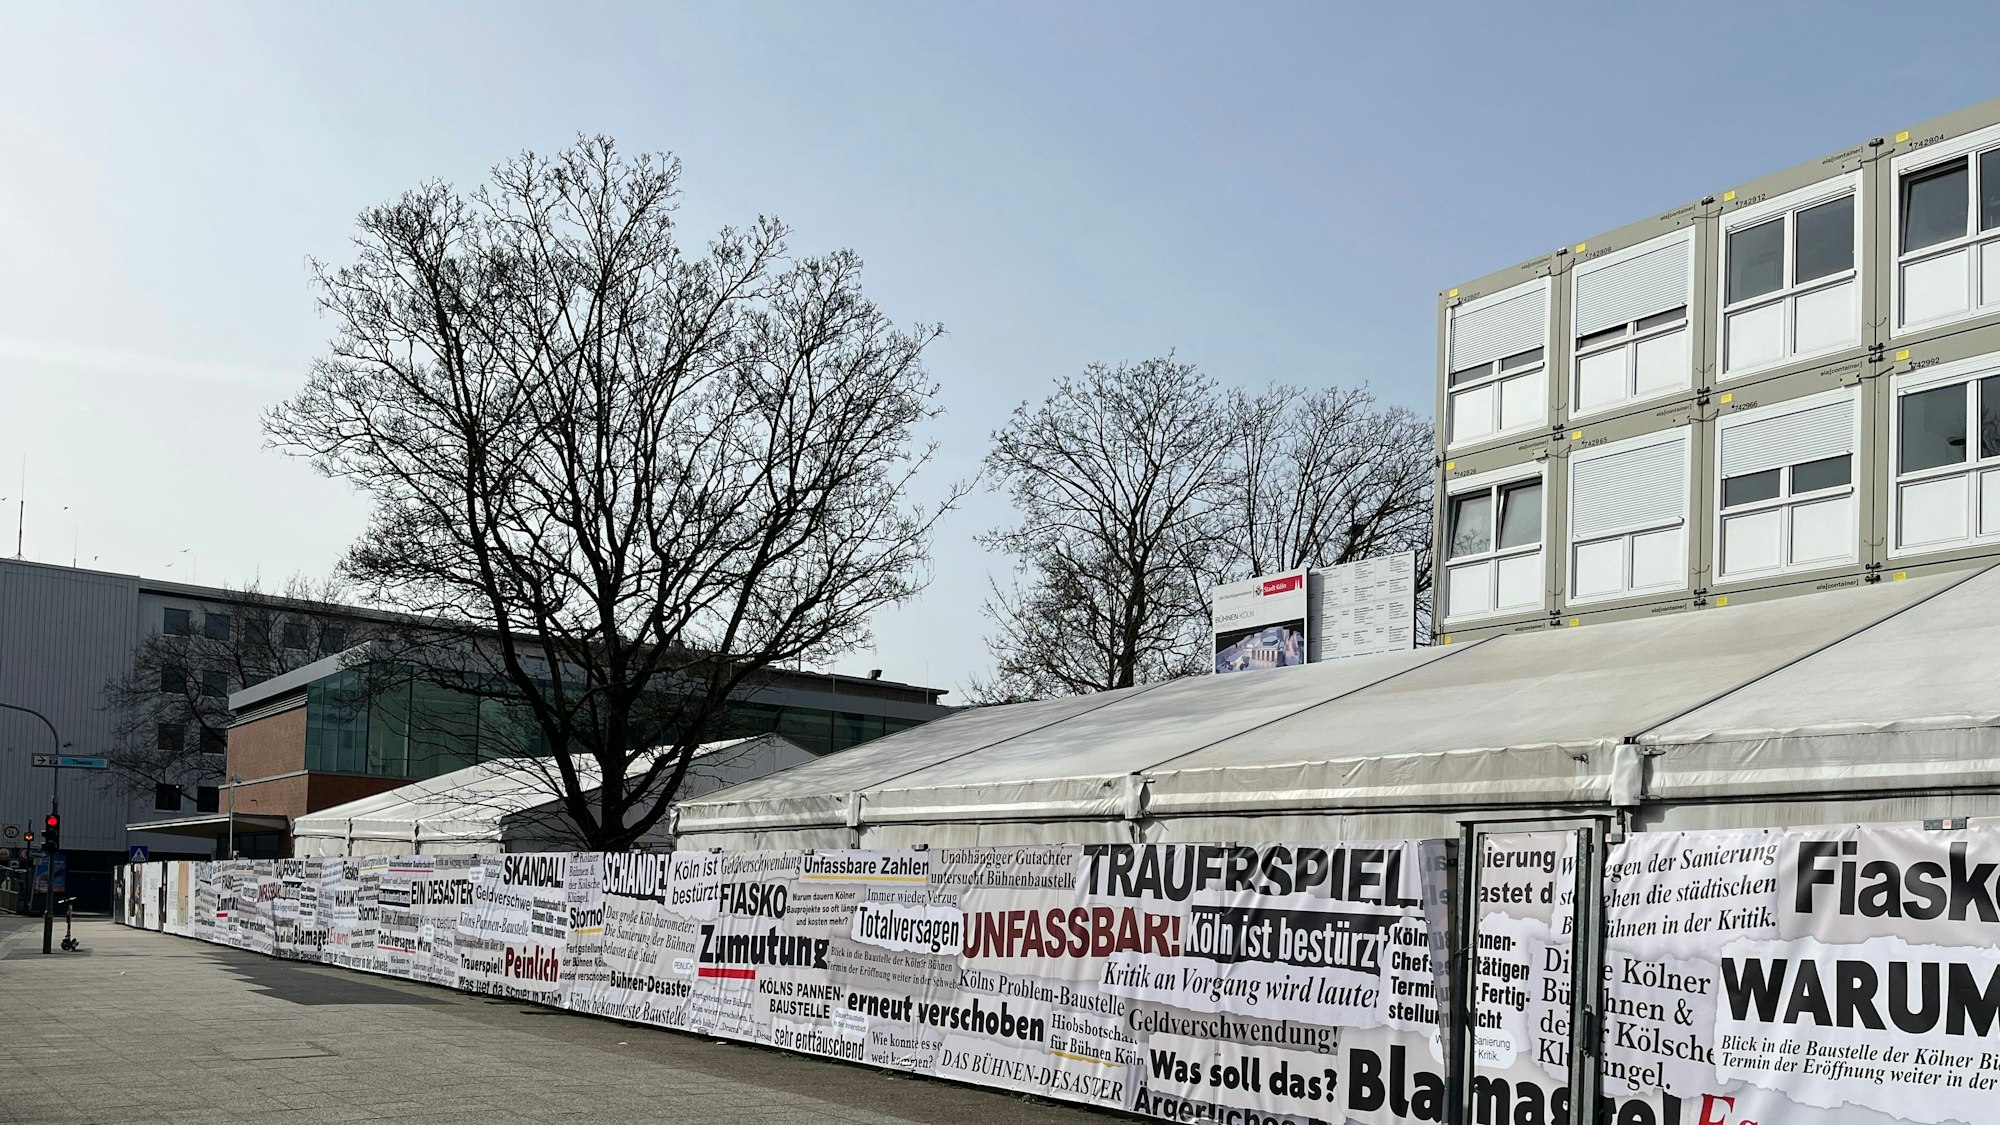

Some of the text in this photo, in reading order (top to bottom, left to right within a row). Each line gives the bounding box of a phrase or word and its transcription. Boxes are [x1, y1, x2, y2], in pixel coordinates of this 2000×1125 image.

[1819, 361, 1862, 376] ela[container]
[1264, 585, 1276, 593] Stadt
[1816, 582, 1859, 592] ela[container]
[1215, 609, 1255, 624] BÜHNEN KÖLN
[674, 857, 718, 881] Köln ist
[804, 856, 929, 876] Unfassbare Zahlen
[941, 849, 1072, 869] Unabhängiger Gutachter
[1647, 853, 1676, 872] der
[1680, 844, 1778, 871] Sanierung
[504, 855, 565, 889] SKANDAL!
[603, 852, 669, 896] SCHANDE!
[931, 871, 1076, 889] untersucht Bühnenbaustelle
[411, 881, 425, 905] EIN
[427, 879, 473, 905] DESASTER
[672, 882, 718, 905] bestürzt
[718, 883, 787, 920] FIASKO
[793, 893, 811, 901] Warum
[836, 891, 855, 899] Kölner
[867, 889, 957, 907] Immer wieder Verzug
[1647, 875, 1777, 905] die städtischen
[570, 902, 606, 929] Storno!
[606, 906, 694, 933] Das große Kölnbarometer:
[787, 905, 820, 915] Bauprojekte
[830, 917, 848, 925] mehr?
[1663, 907, 1777, 934] in der Kritik.
[294, 925, 329, 951] Blamage!
[476, 914, 528, 937] Pannen-Baustelle
[604, 924, 695, 953] Die Sanierung der Bühnen
[860, 906, 959, 952] Totalversagen
[963, 907, 1181, 958] UNFASSBAR!
[378, 930, 416, 953] Totalversagen.
[603, 940, 658, 965] belastet die Stadt
[699, 923, 830, 969] Zumutung
[1186, 912, 1389, 969] Köln ist bestürzt
[460, 954, 503, 978] Trauerspiel!
[505, 945, 558, 982] Peinlich
[563, 957, 592, 967] der Bühnen
[827, 960, 847, 972] Termin
[849, 964, 858, 974] der
[860, 966, 890, 982] Eröffnung
[892, 972, 910, 983] weiter
[913, 974, 919, 984] in
[920, 975, 931, 985] der
[831, 946, 845, 958] Blick
[847, 948, 852, 958] in
[854, 949, 862, 960] die
[865, 951, 891, 964] Baustelle
[893, 955, 902, 966] der
[928, 959, 952, 972] Bühnen
[611, 971, 691, 998] Bühnen-Desaster
[760, 977, 844, 1001] KÖLNS PANNEN-
[1103, 962, 1312, 1005] Kritik an Vorgang wird
[1622, 958, 1710, 994] Kölner
[960, 969, 1125, 1016] Kölns Problem-Baustelle
[1481, 983, 1530, 1011] Fertig-
[592, 996, 641, 1021] bekannteste
[643, 1002, 686, 1026] Baustelle
[770, 999, 830, 1019] BAUSTELLE
[848, 992, 1044, 1043] erneut verschoben
[1674, 998, 1694, 1026] &
[775, 1025, 792, 1048] sehr
[796, 1031, 864, 1061] enttäuschend
[872, 1032, 930, 1050] Wie konnte es
[1129, 1008, 1338, 1054] Geldverschwendung!
[1615, 1021, 1716, 1065] Kölsche
[872, 1052, 889, 1065] weit
[1050, 1034, 1144, 1065] für Bühnen Köln
[1479, 1050, 1499, 1061] Kritik.
[1722, 1035, 1974, 1069] Blick in die Baustelle der Kölner
[941, 1049, 1123, 1101] DAS BÜHNEN-DESASTER
[1150, 1049, 1337, 1103] Was soll das?
[1722, 1052, 1998, 1090] Termin der Eröffnung weiter in der
